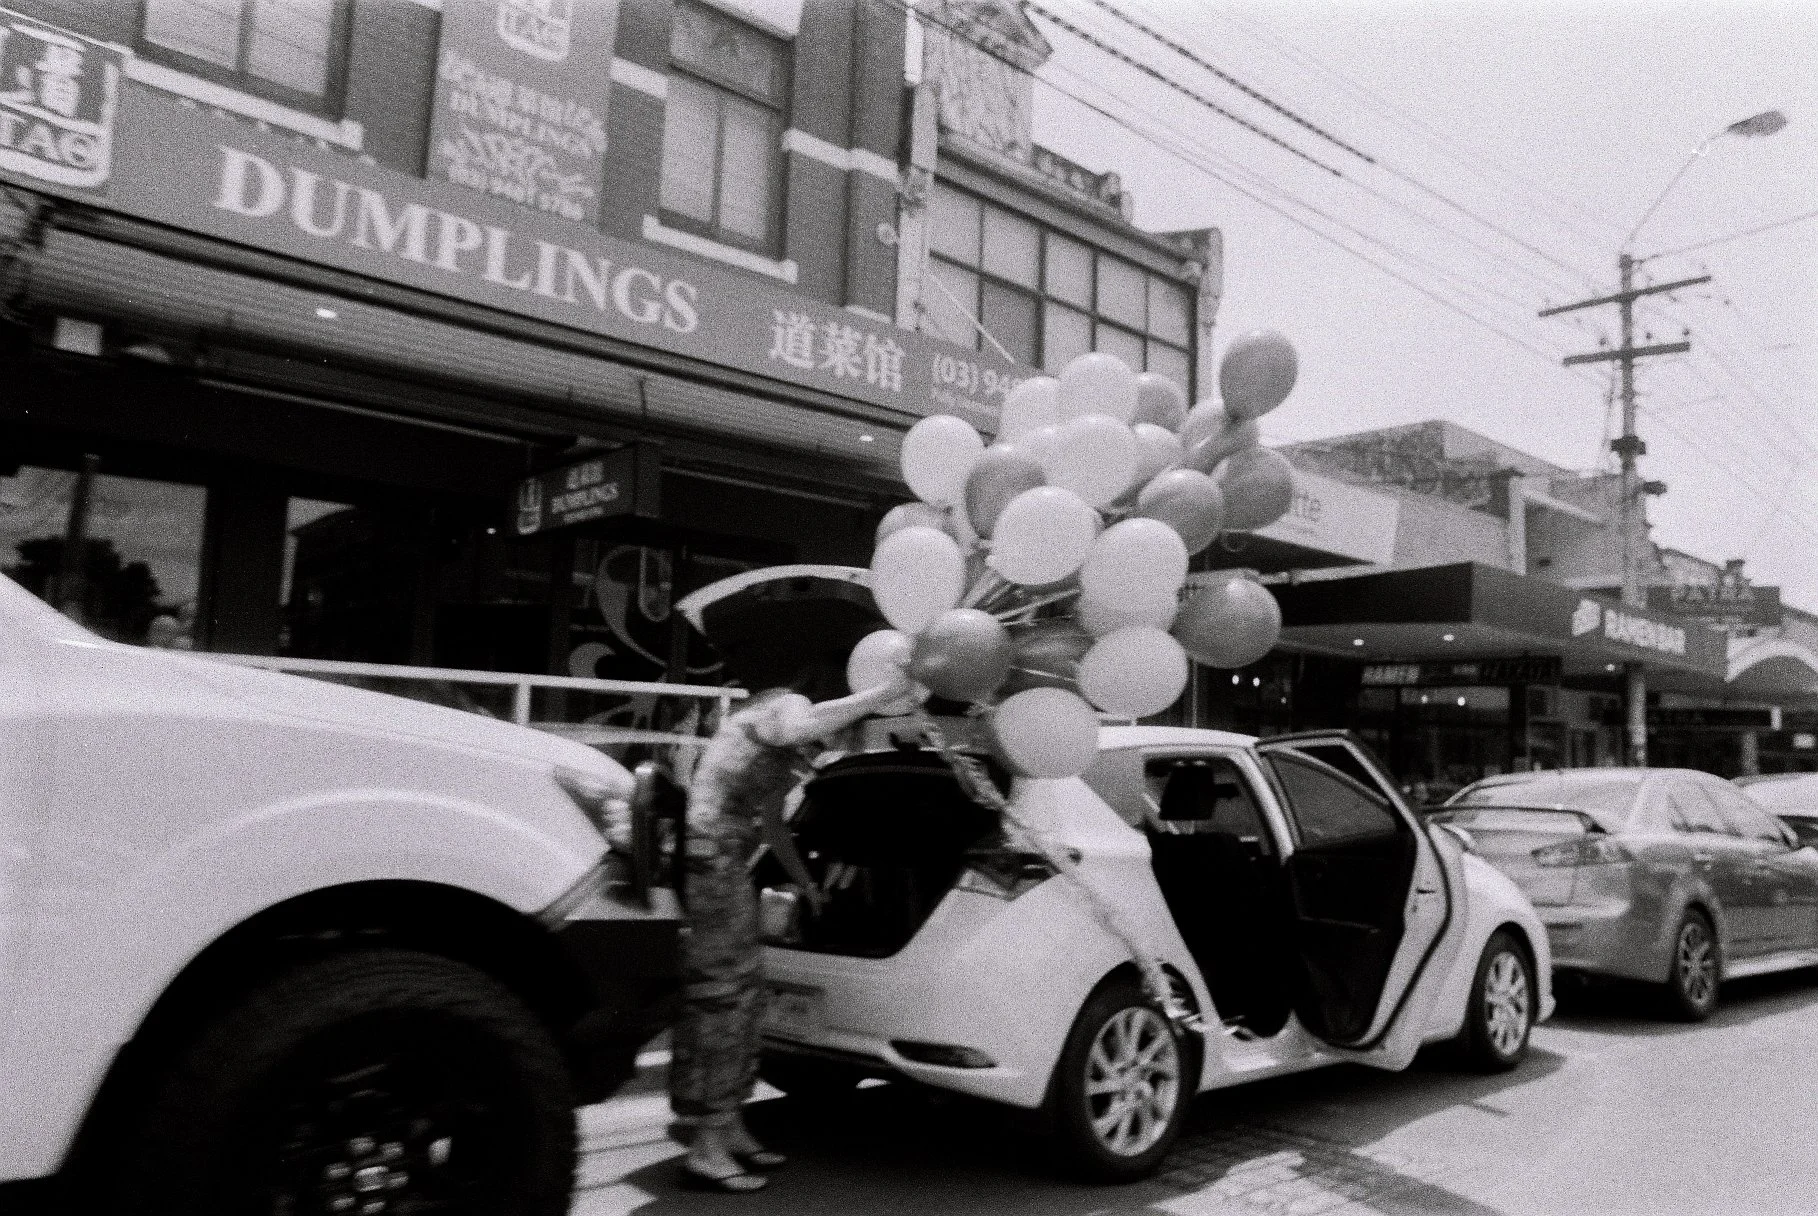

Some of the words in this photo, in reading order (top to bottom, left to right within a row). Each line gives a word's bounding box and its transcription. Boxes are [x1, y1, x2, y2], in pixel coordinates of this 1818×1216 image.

[213, 146, 699, 333] DUMPLINGS
[769, 309, 906, 392] 道菜馆
[931, 352, 979, 395] (03)
